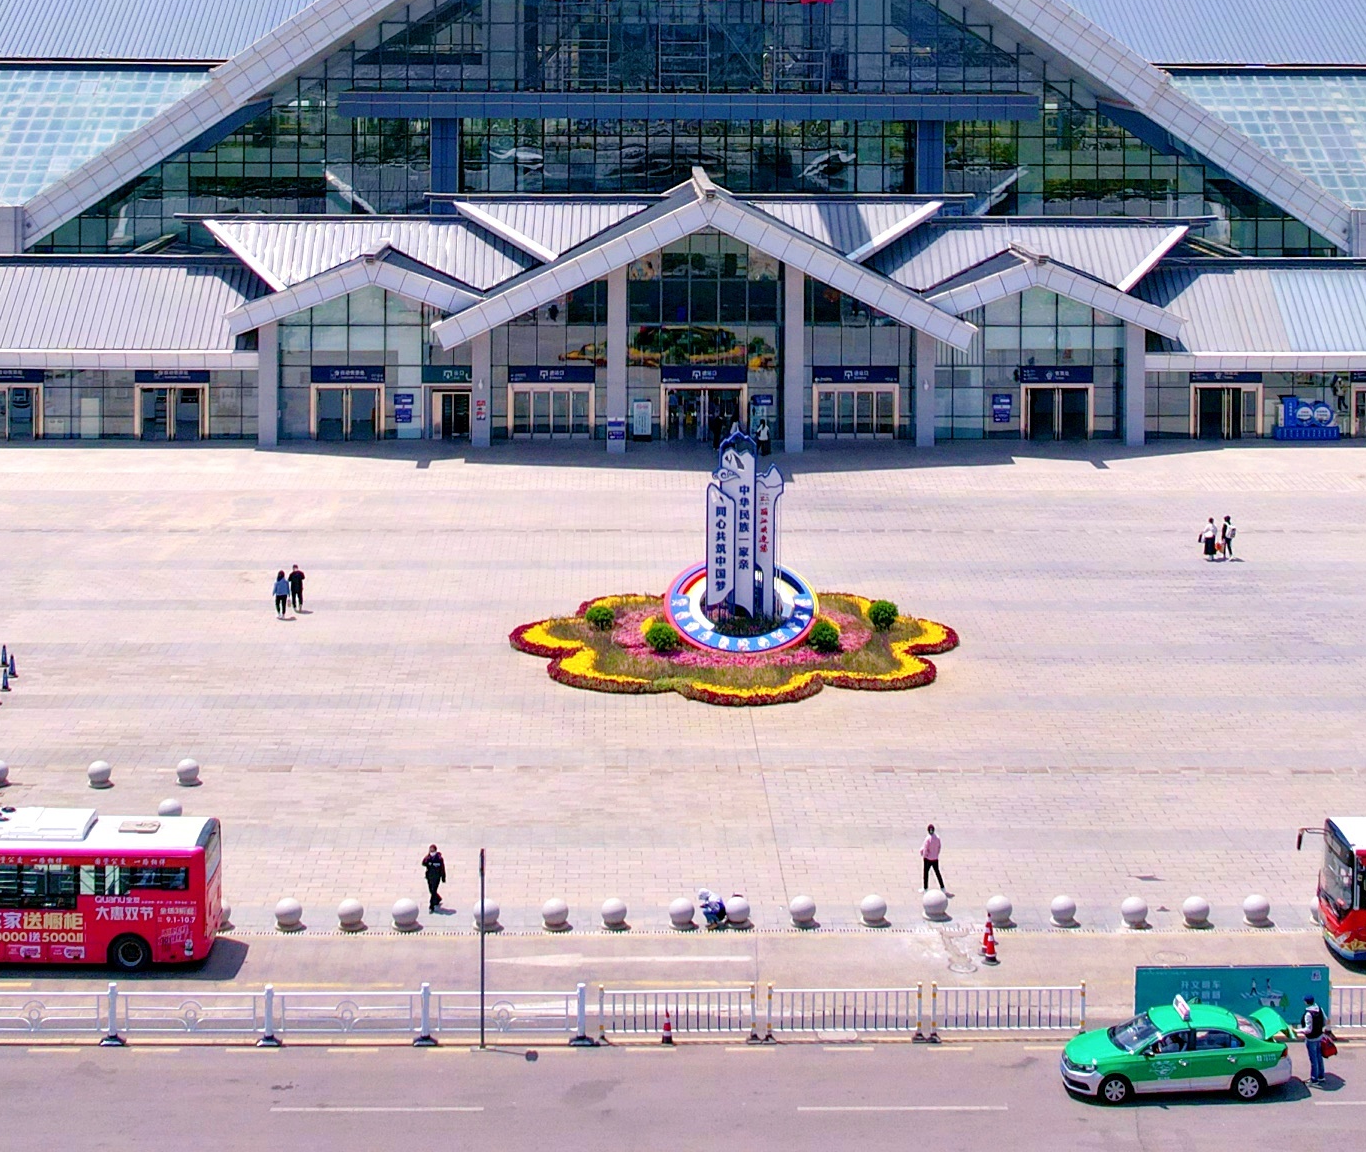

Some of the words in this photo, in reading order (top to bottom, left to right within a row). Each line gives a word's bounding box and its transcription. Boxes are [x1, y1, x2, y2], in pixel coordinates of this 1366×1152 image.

[738, 485, 750, 570] 中华民族一家亲
[716, 506, 727, 592] 同心共筑中国梦
[95, 896, 126, 904] Quanu
[95, 906, 154, 921] 大惠双节
[166, 916, 196, 924] 9.1-10.7
